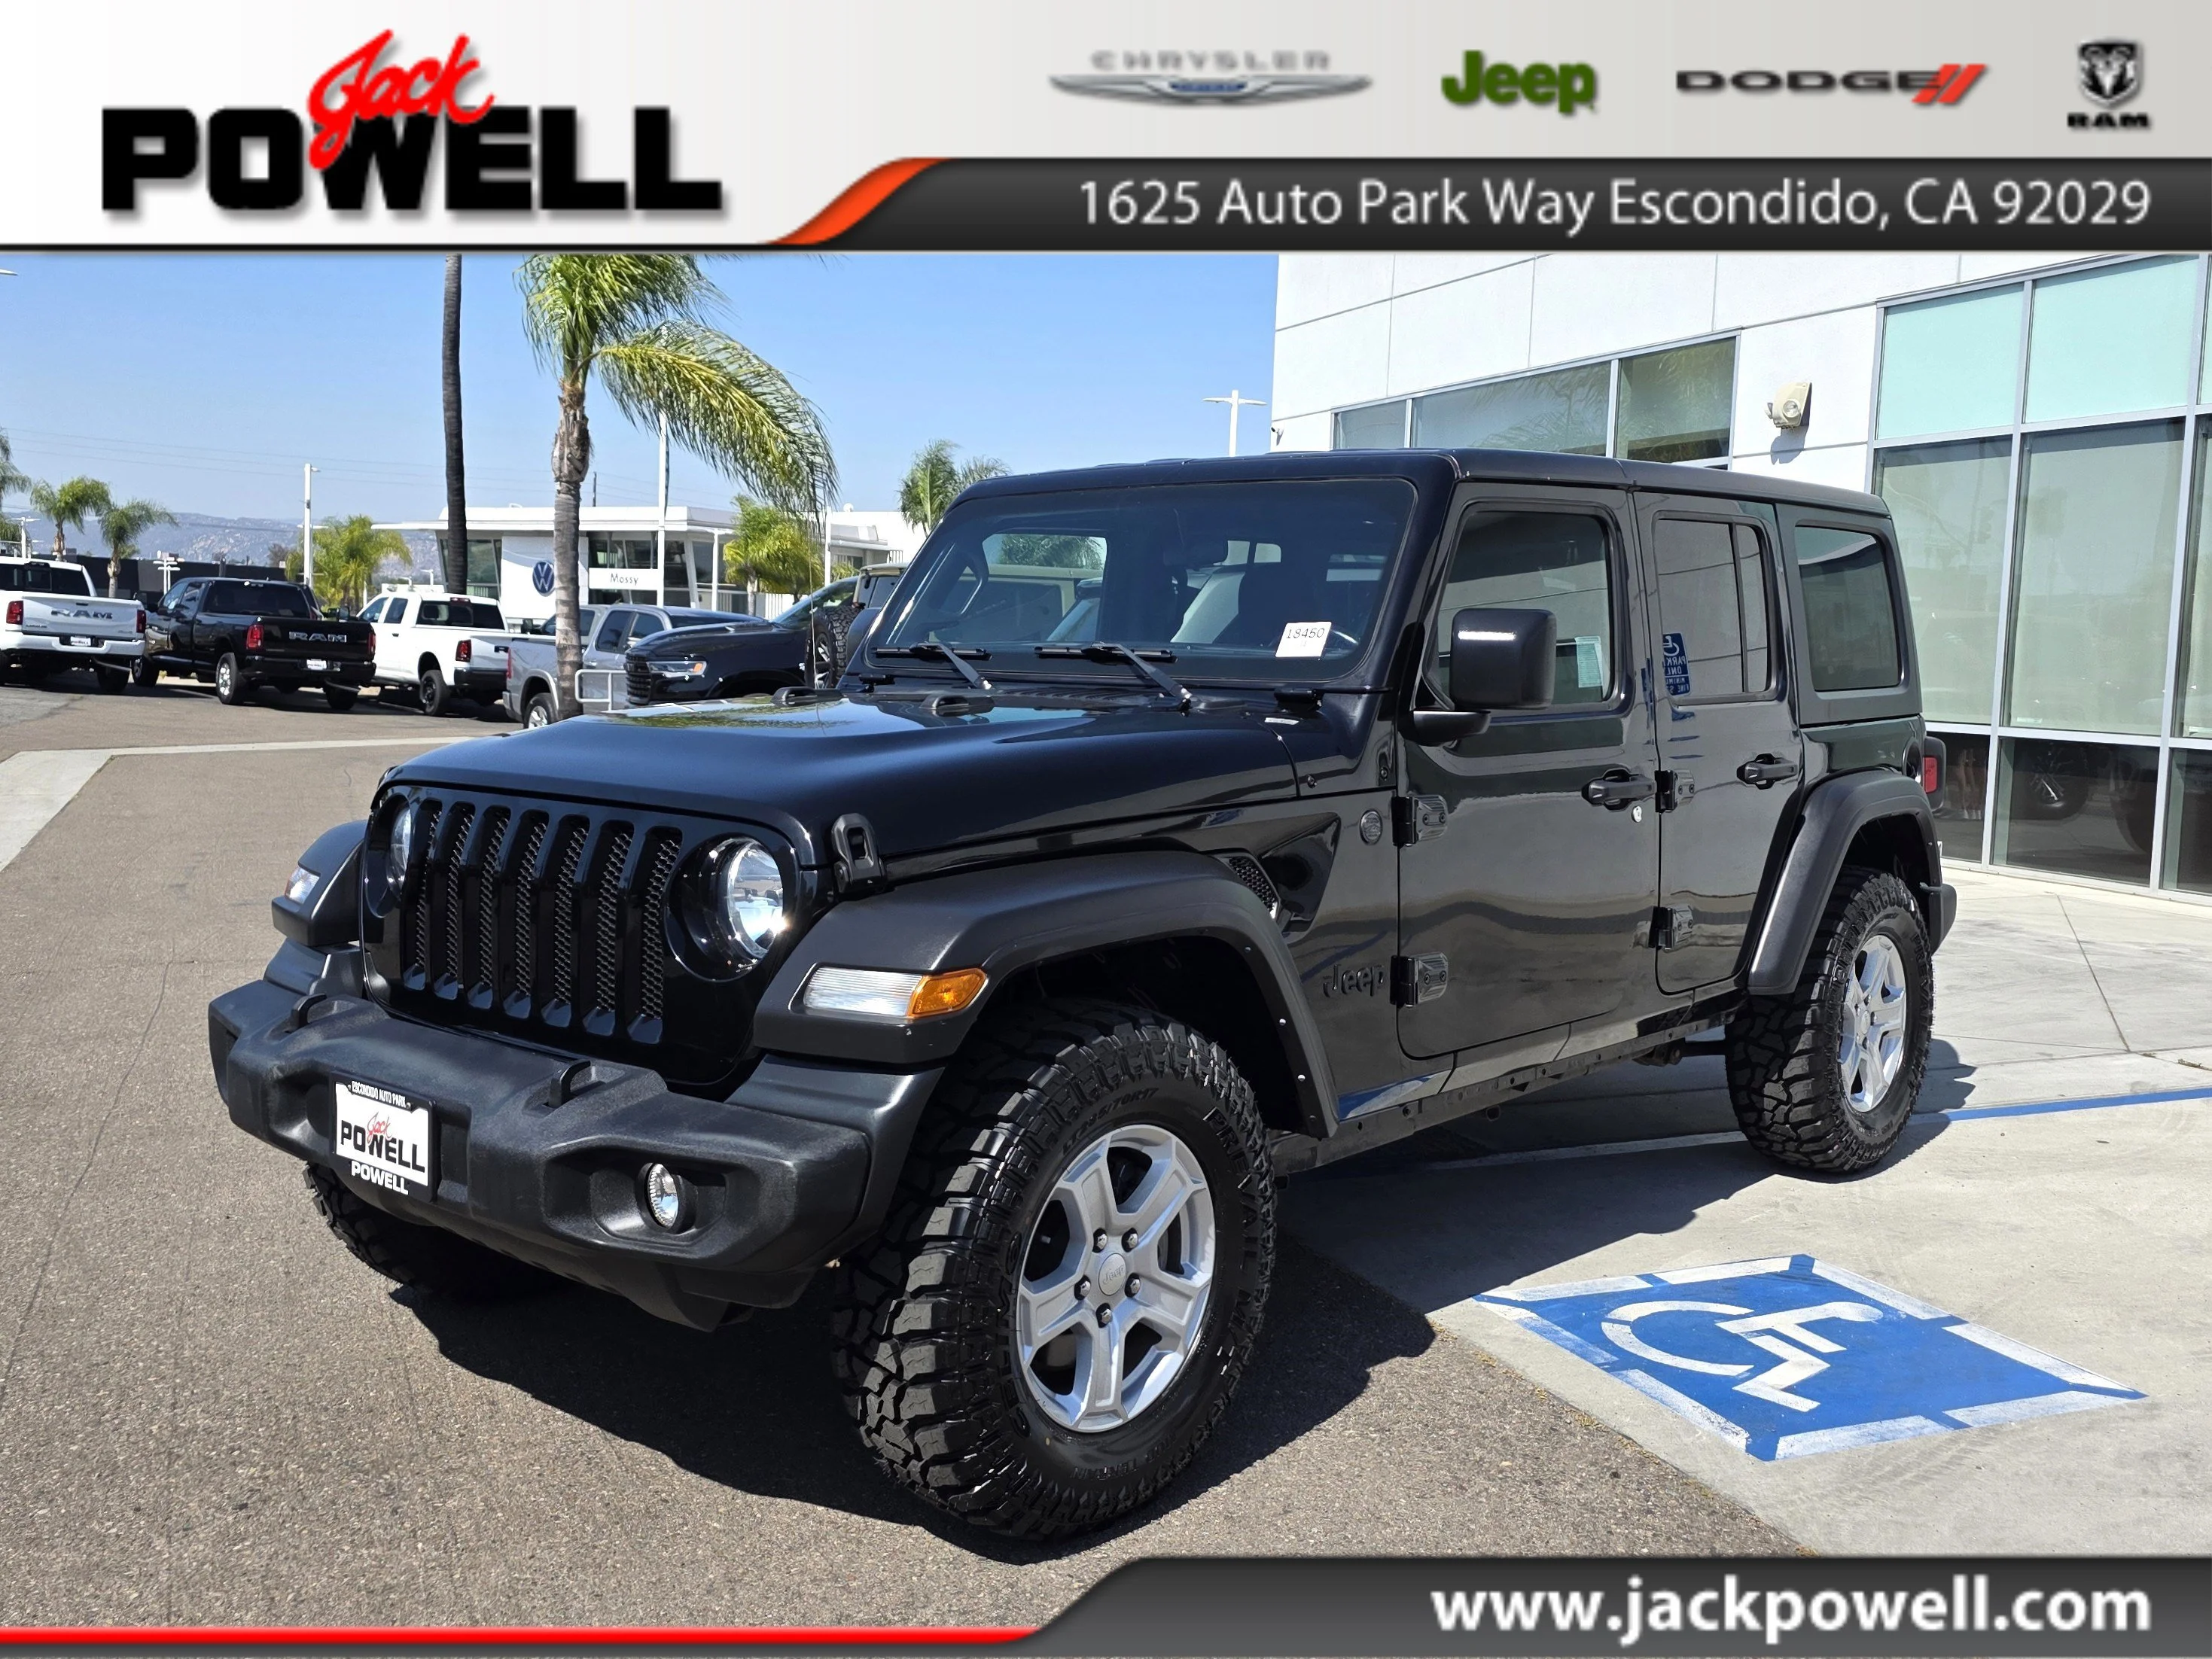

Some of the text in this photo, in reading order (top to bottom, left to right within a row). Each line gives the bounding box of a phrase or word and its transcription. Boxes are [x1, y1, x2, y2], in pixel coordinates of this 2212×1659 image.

[610, 573, 639, 586] Mossy
[50, 610, 113, 619] RAM
[289, 632, 346, 643] RAM
[1323, 964, 1385, 997] Jeep
[352, 1081, 407, 1108] ESCONDIDO AUTO PARK
[367, 1111, 393, 1144] Jack
[340, 1119, 425, 1173] POWELL
[351, 1160, 409, 1195] POWELL
[1102, 1265, 1124, 1285] Jeep
